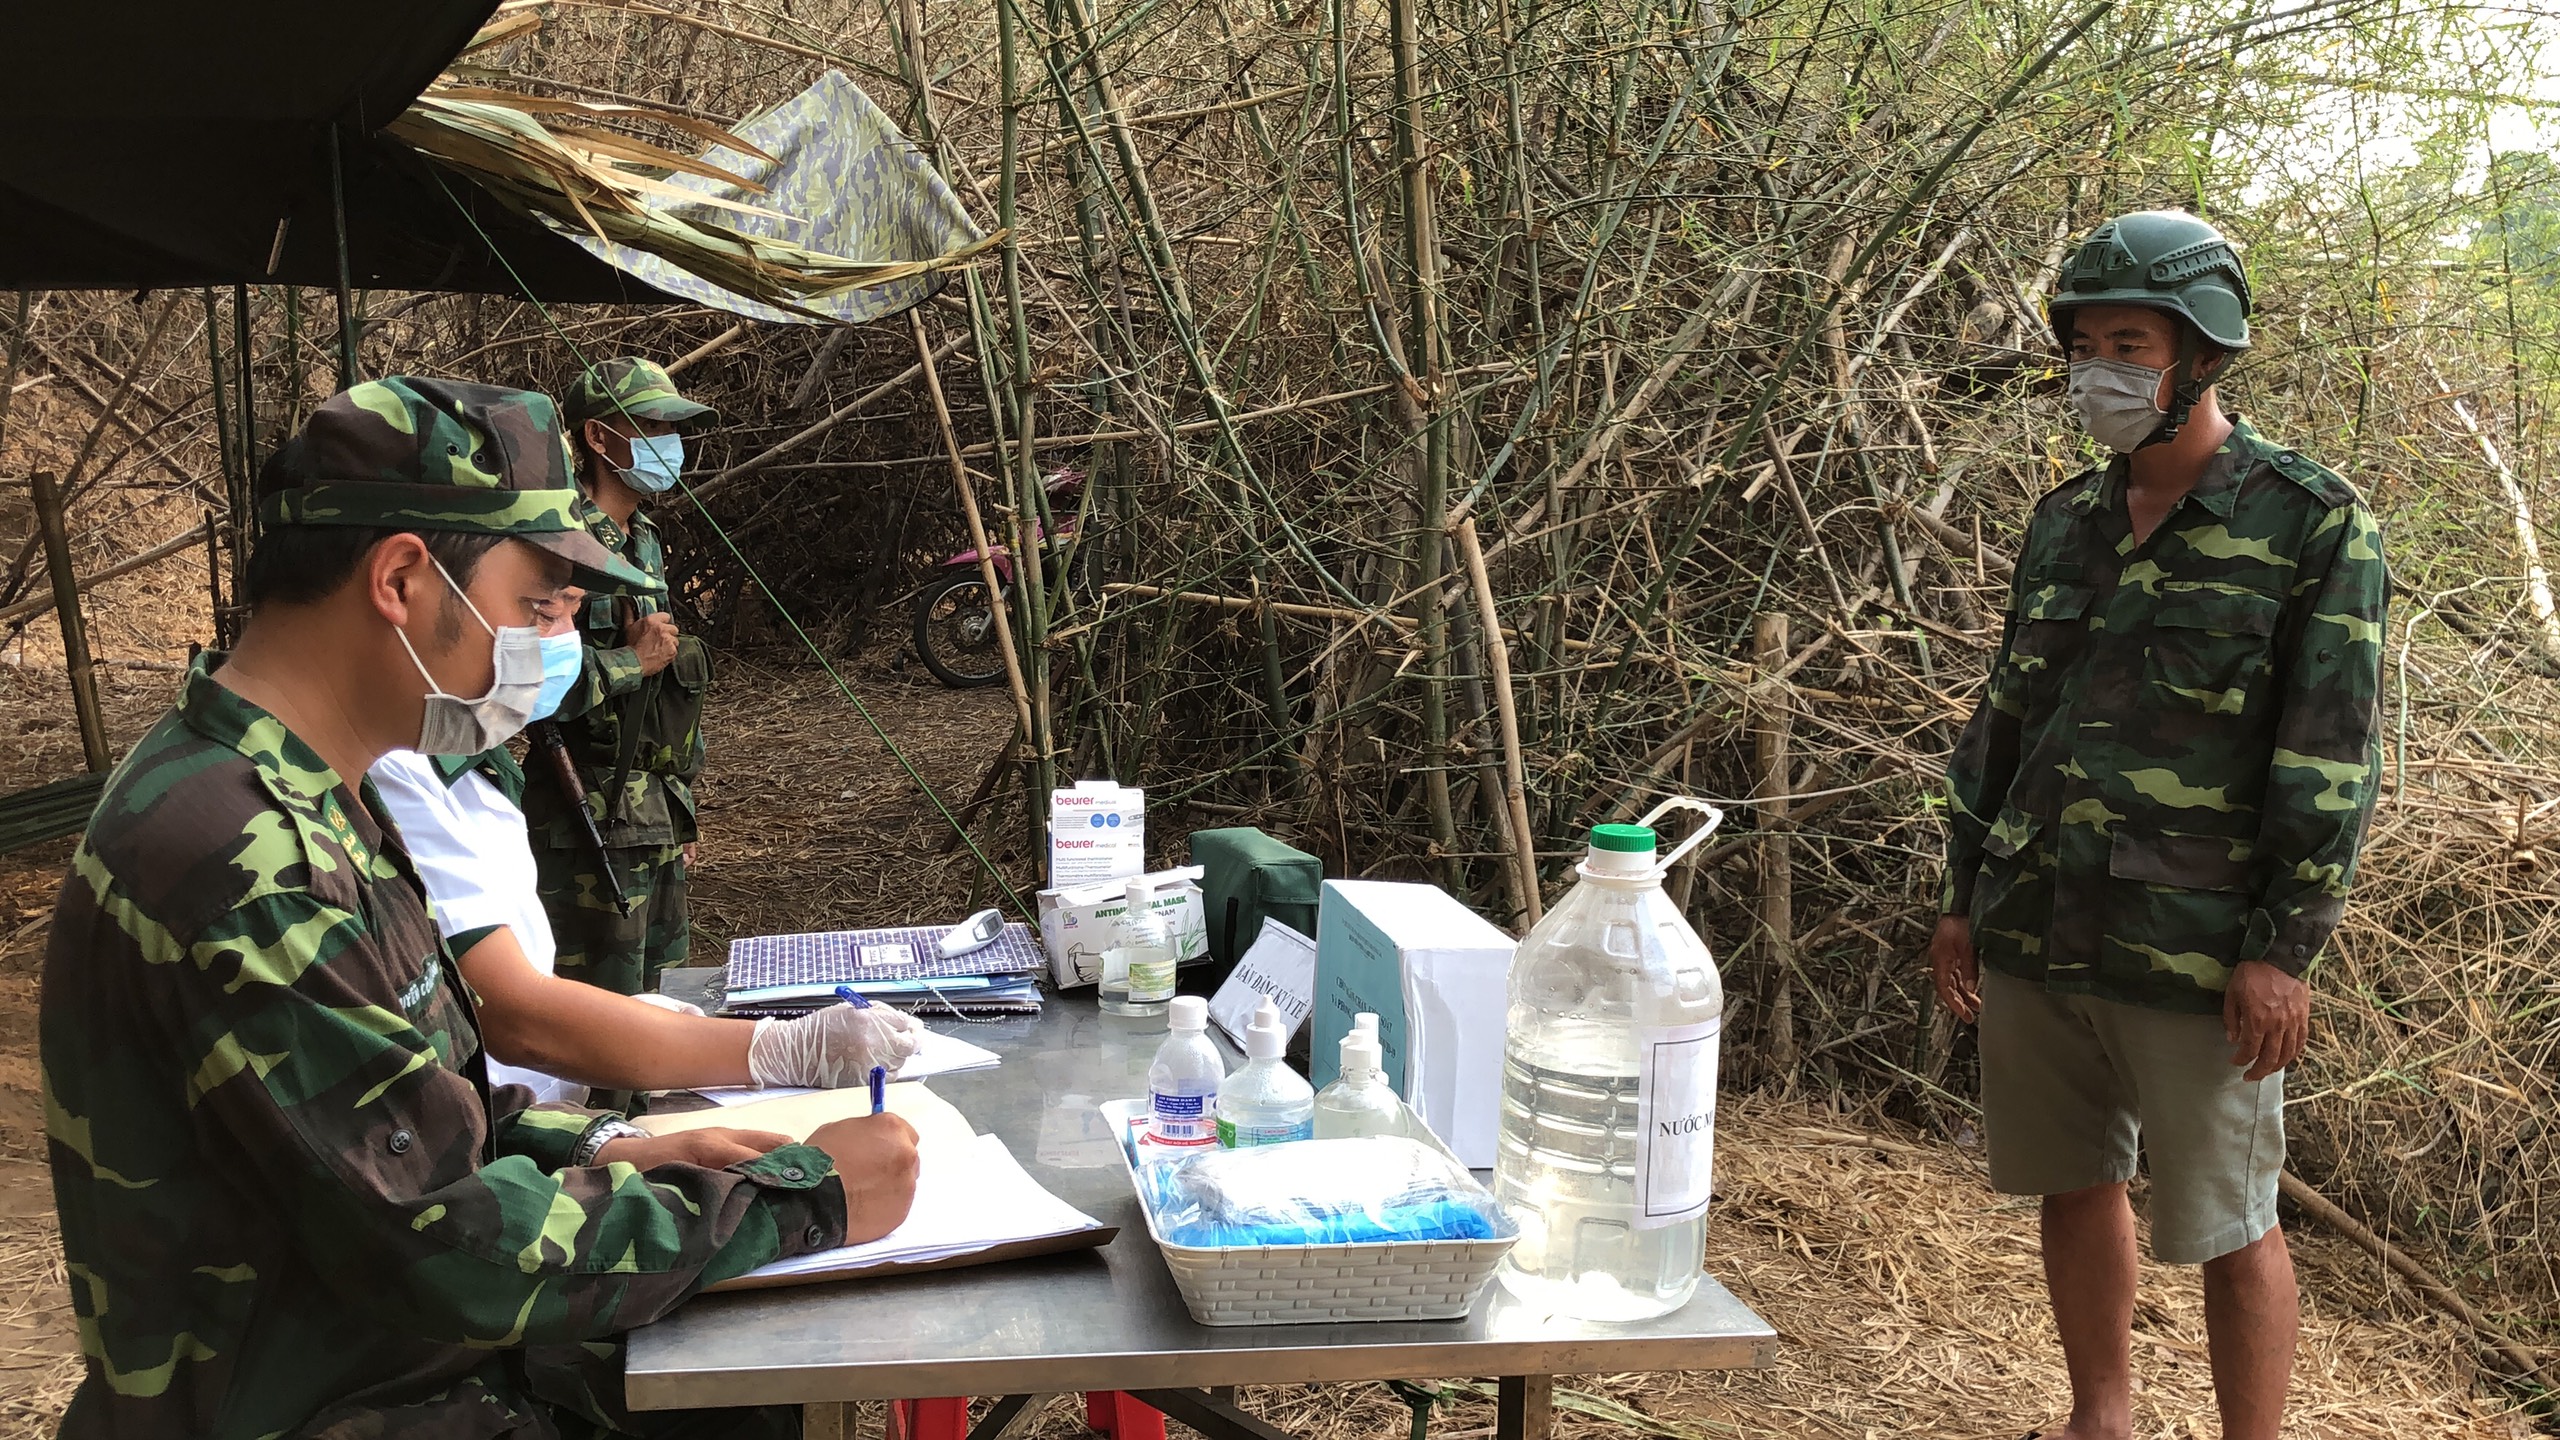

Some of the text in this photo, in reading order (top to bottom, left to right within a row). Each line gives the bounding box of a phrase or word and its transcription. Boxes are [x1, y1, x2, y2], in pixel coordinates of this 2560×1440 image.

[1056, 795, 1094, 806] beurer
[1056, 838, 1094, 849] beurer
[1163, 895, 1187, 906] MASK
[1659, 1113, 1702, 1137] NƯỚC
